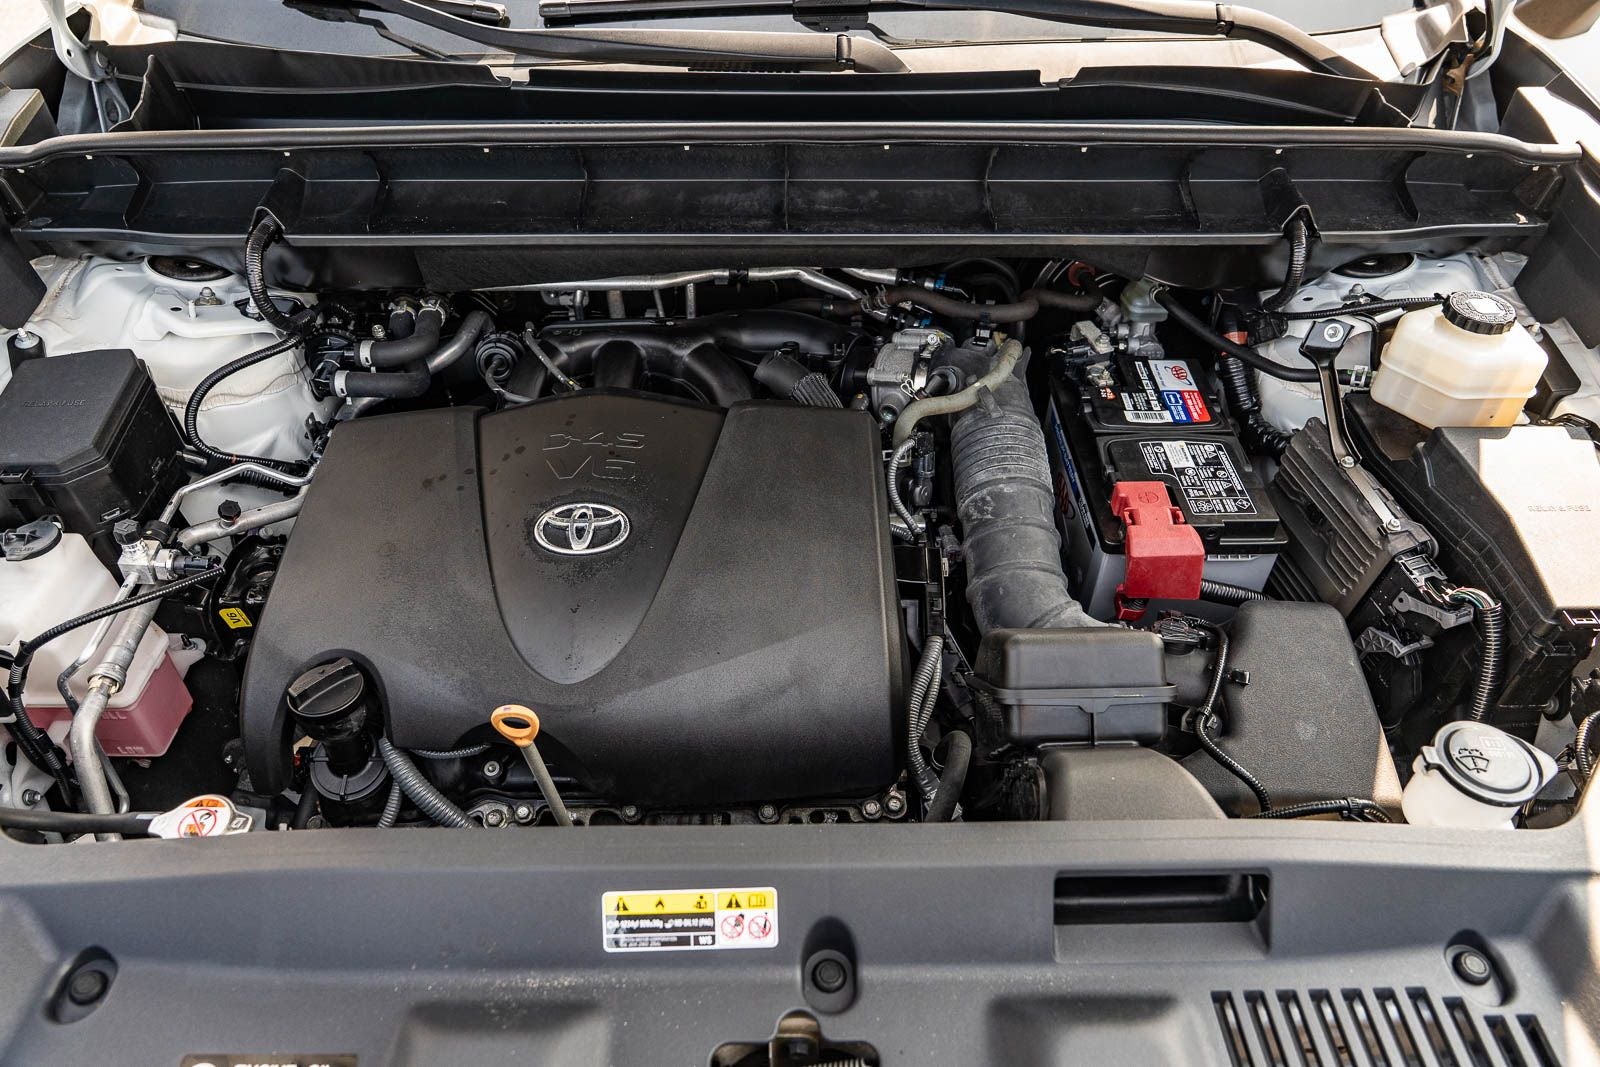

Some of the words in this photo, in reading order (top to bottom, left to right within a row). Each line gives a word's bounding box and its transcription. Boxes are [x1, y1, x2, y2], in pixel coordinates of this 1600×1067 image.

[545, 455, 637, 480] V6
[226, 612, 242, 624] V6
[117, 746, 146, 755] LOW
